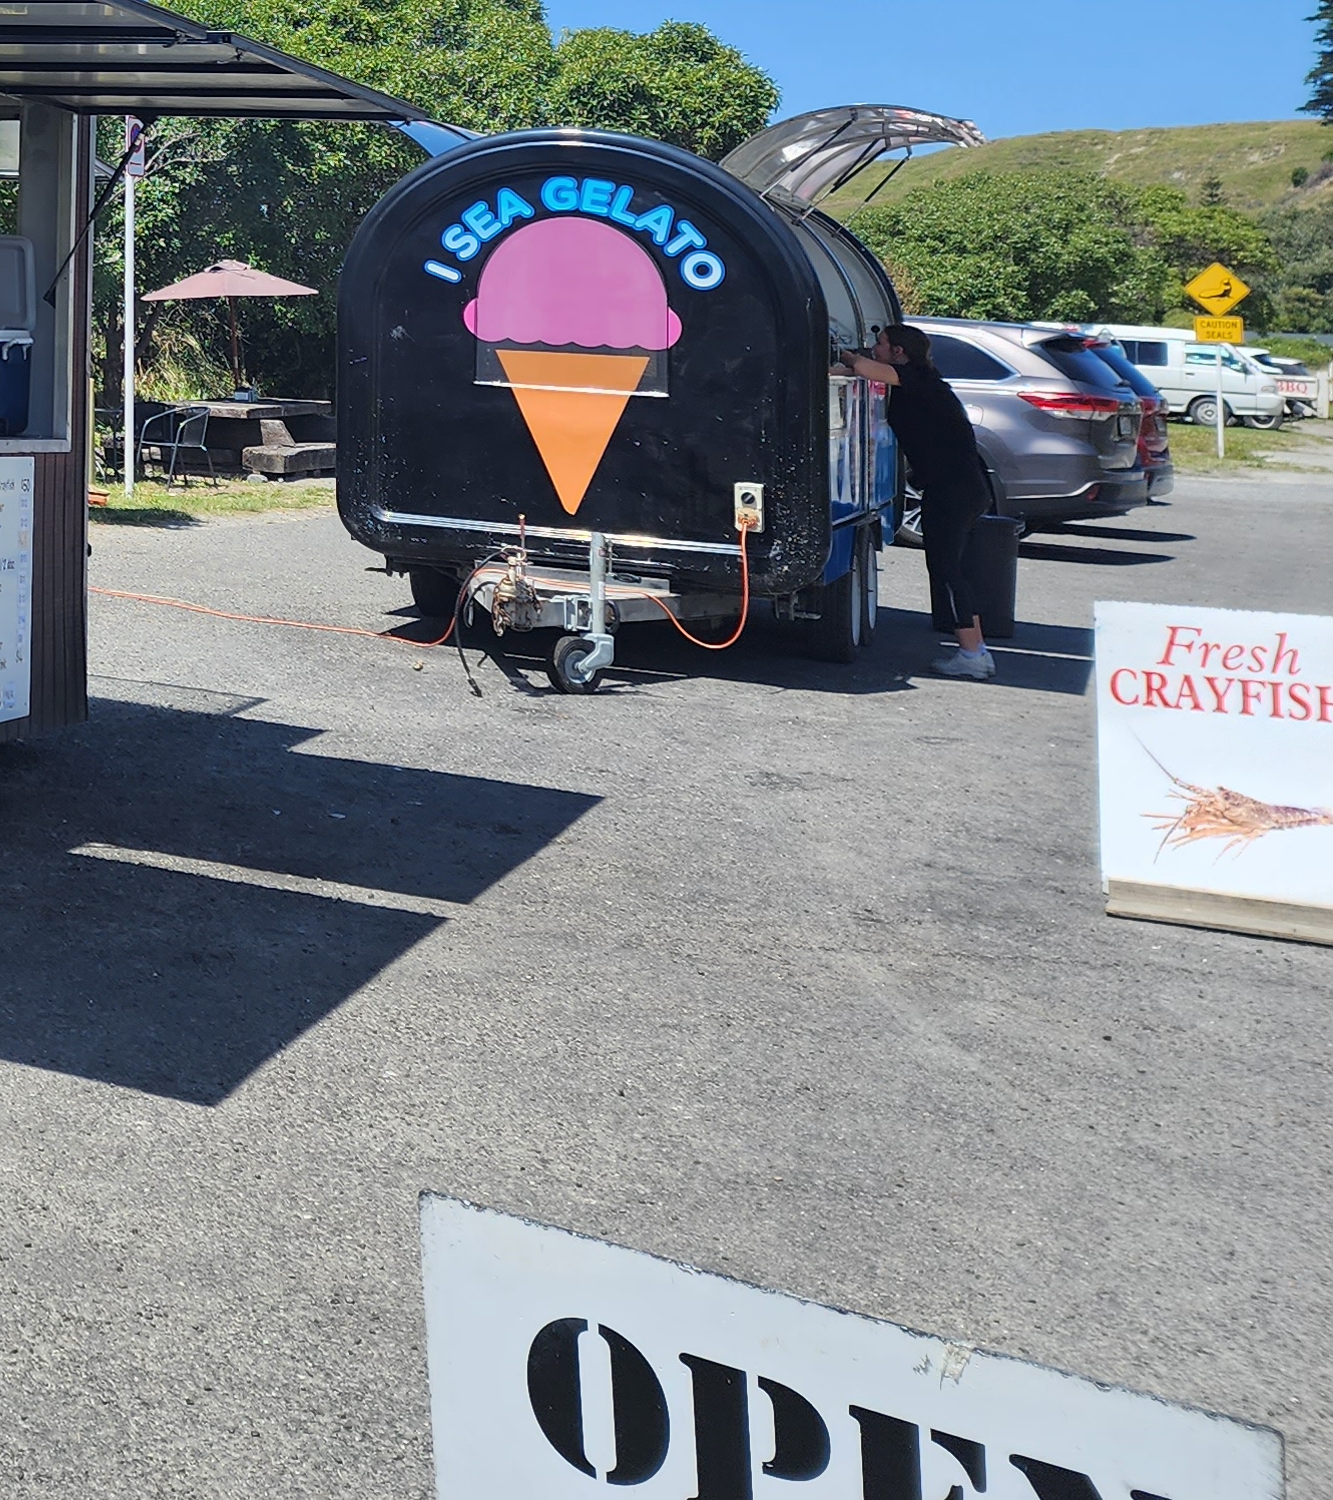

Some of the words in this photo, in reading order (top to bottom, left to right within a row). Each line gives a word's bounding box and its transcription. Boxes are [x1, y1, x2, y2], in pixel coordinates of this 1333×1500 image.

[442, 186, 534, 261] SEA
[541, 176, 726, 290] GELATO
[424, 258, 462, 283] I
[1200, 321, 1238, 329] CAUTION
[1206, 331, 1233, 339] SEALS
[1156, 625, 1302, 676] Fresh
[527, 1316, 1171, 1500] OPE
